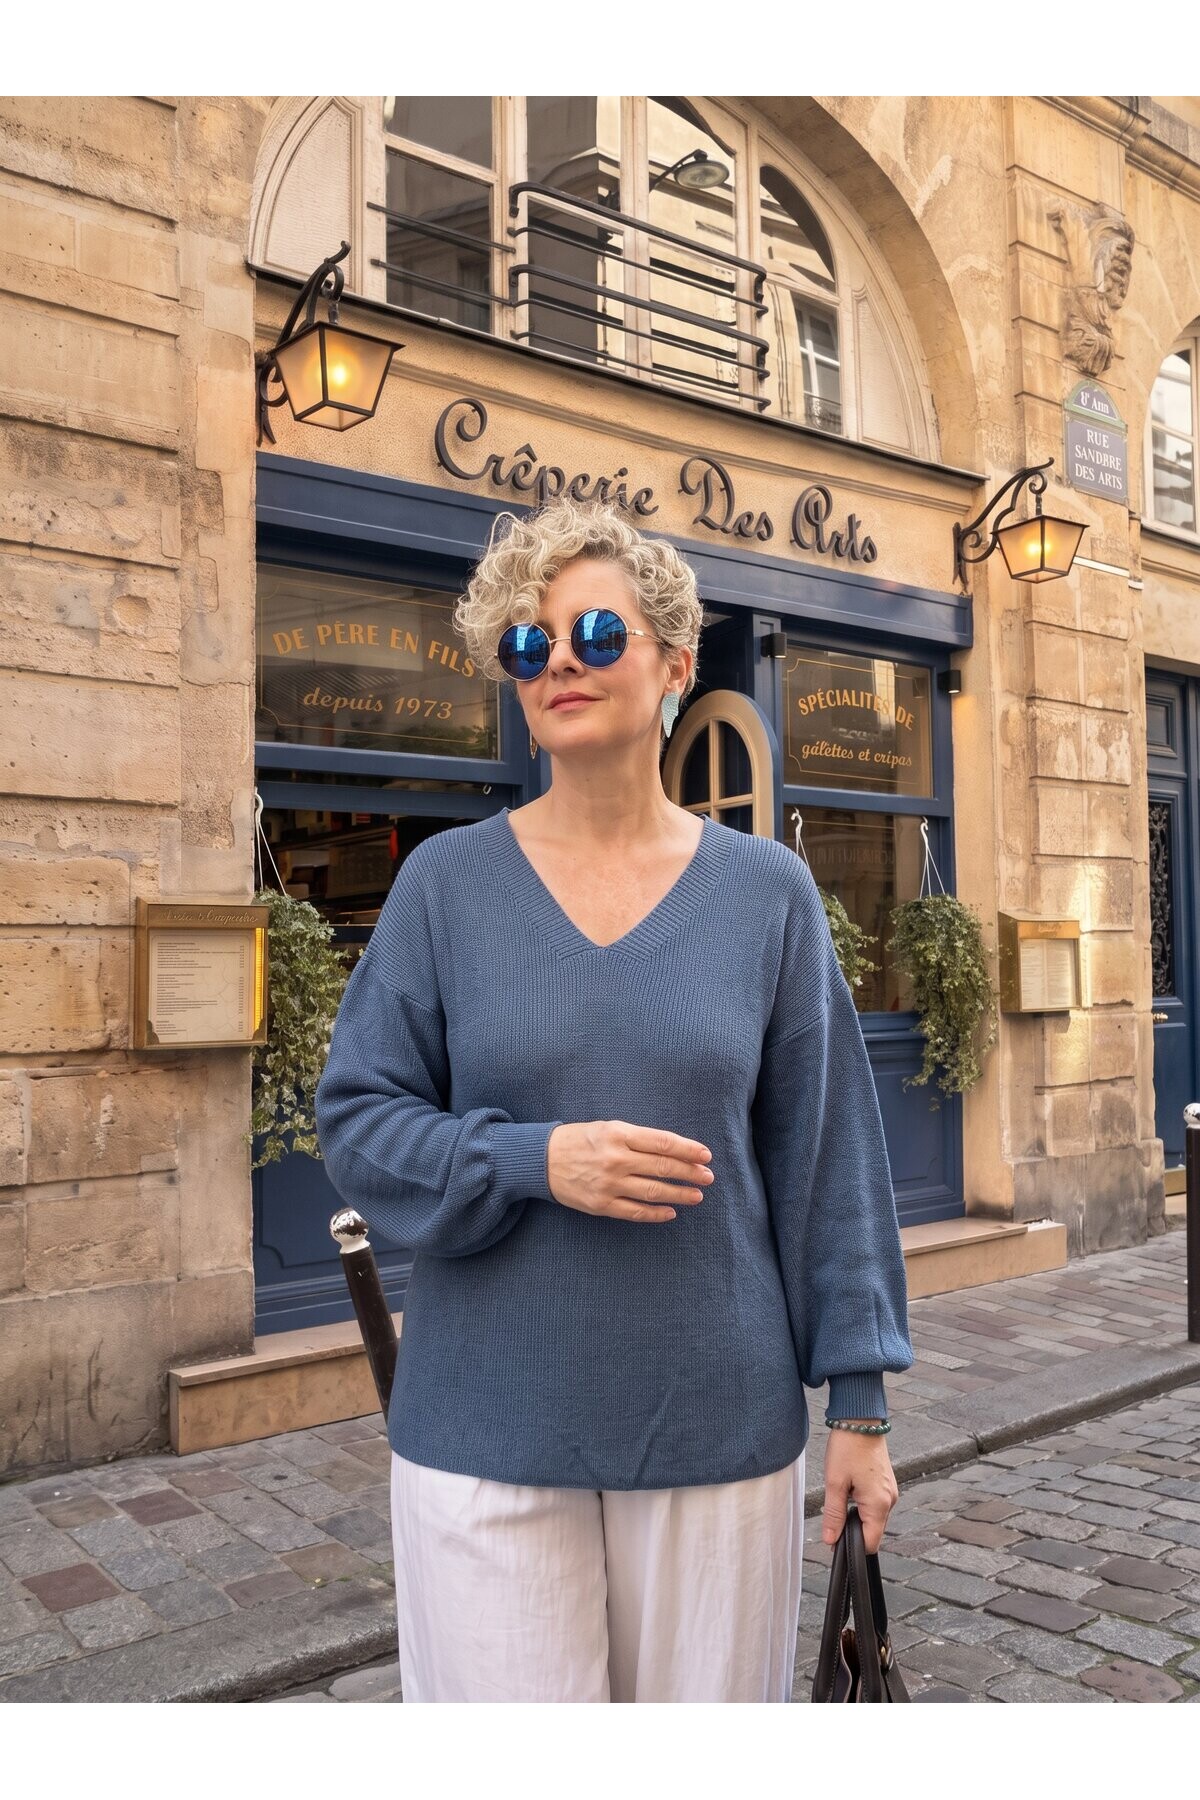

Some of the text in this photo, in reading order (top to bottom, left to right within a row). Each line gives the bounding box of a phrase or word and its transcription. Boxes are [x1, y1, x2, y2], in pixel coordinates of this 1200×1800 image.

[1086, 429, 1110, 449] RUE
[434, 397, 878, 564] Crêperie Des Arts
[1075, 463, 1123, 491] DES ARTS
[272, 620, 477, 679] DE PÈRE EN FILS
[303, 687, 452, 721] depuis 1973
[896, 705, 915, 731] DE
[858, 748, 870, 762] et
